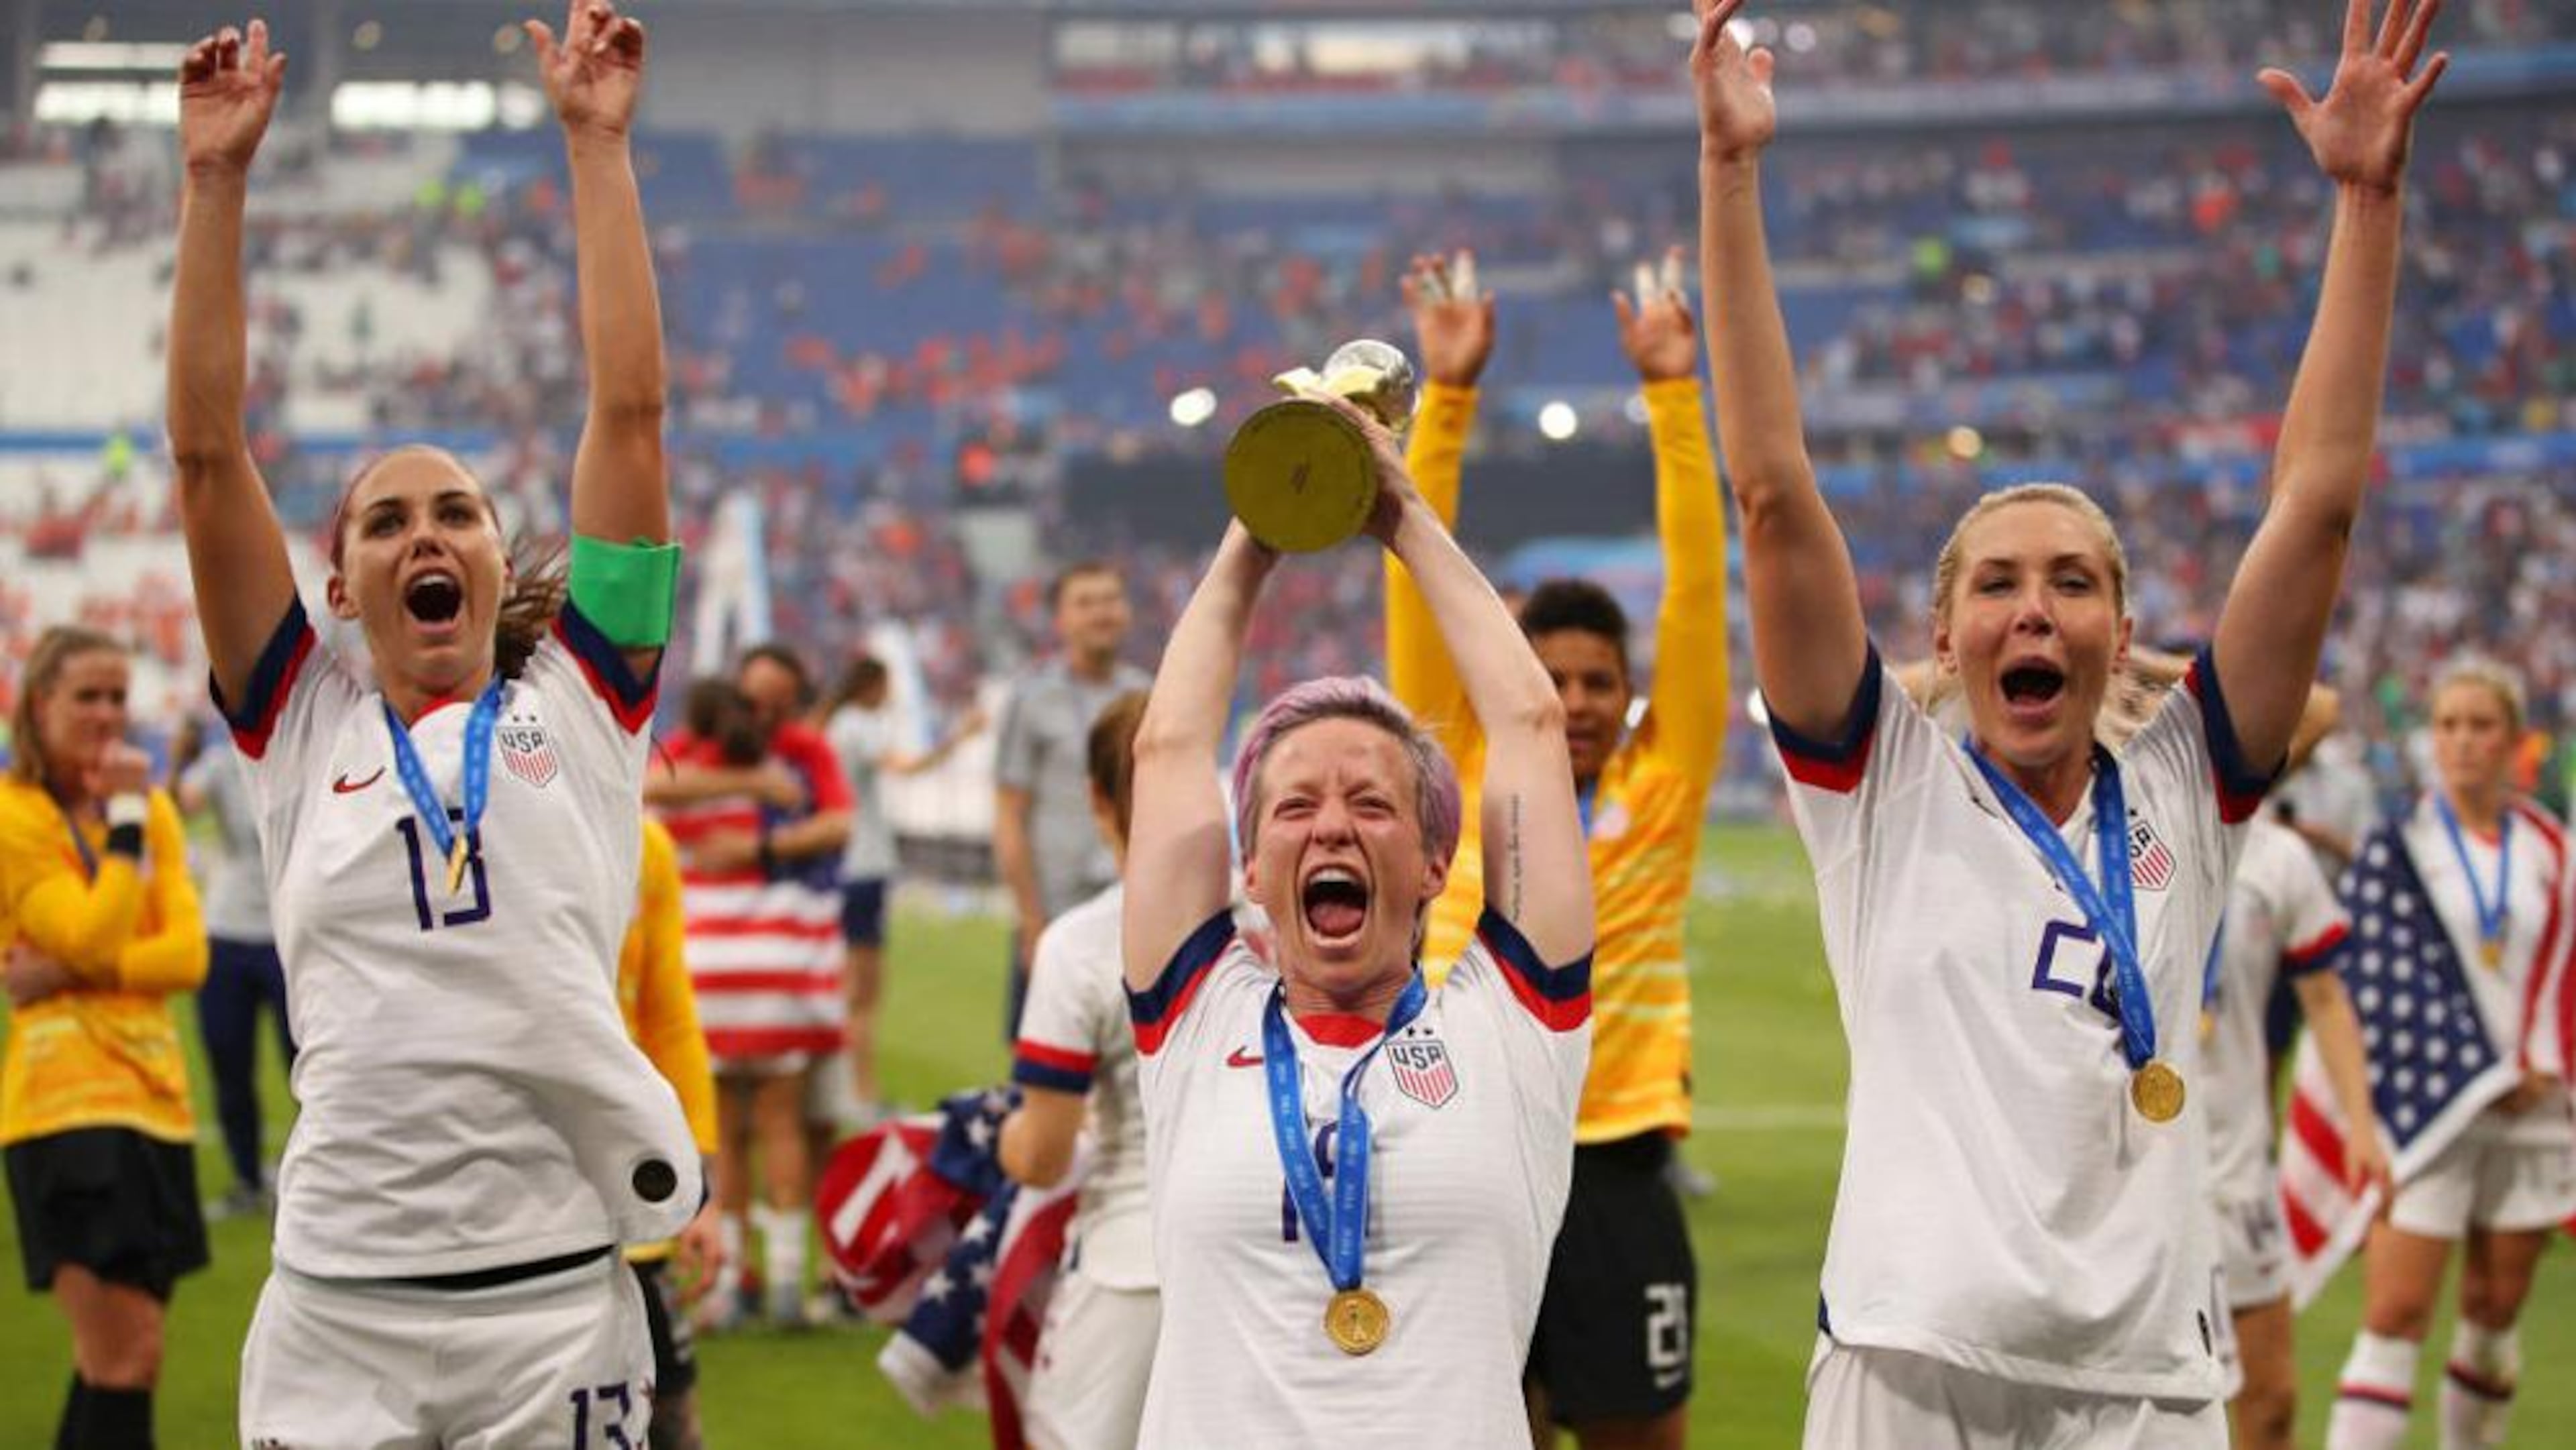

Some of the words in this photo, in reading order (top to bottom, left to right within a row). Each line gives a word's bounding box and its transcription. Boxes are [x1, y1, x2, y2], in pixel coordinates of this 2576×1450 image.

[501, 731, 543, 753] USA
[1393, 1046, 1442, 1070] USA
[570, 1382, 632, 1450] 13
